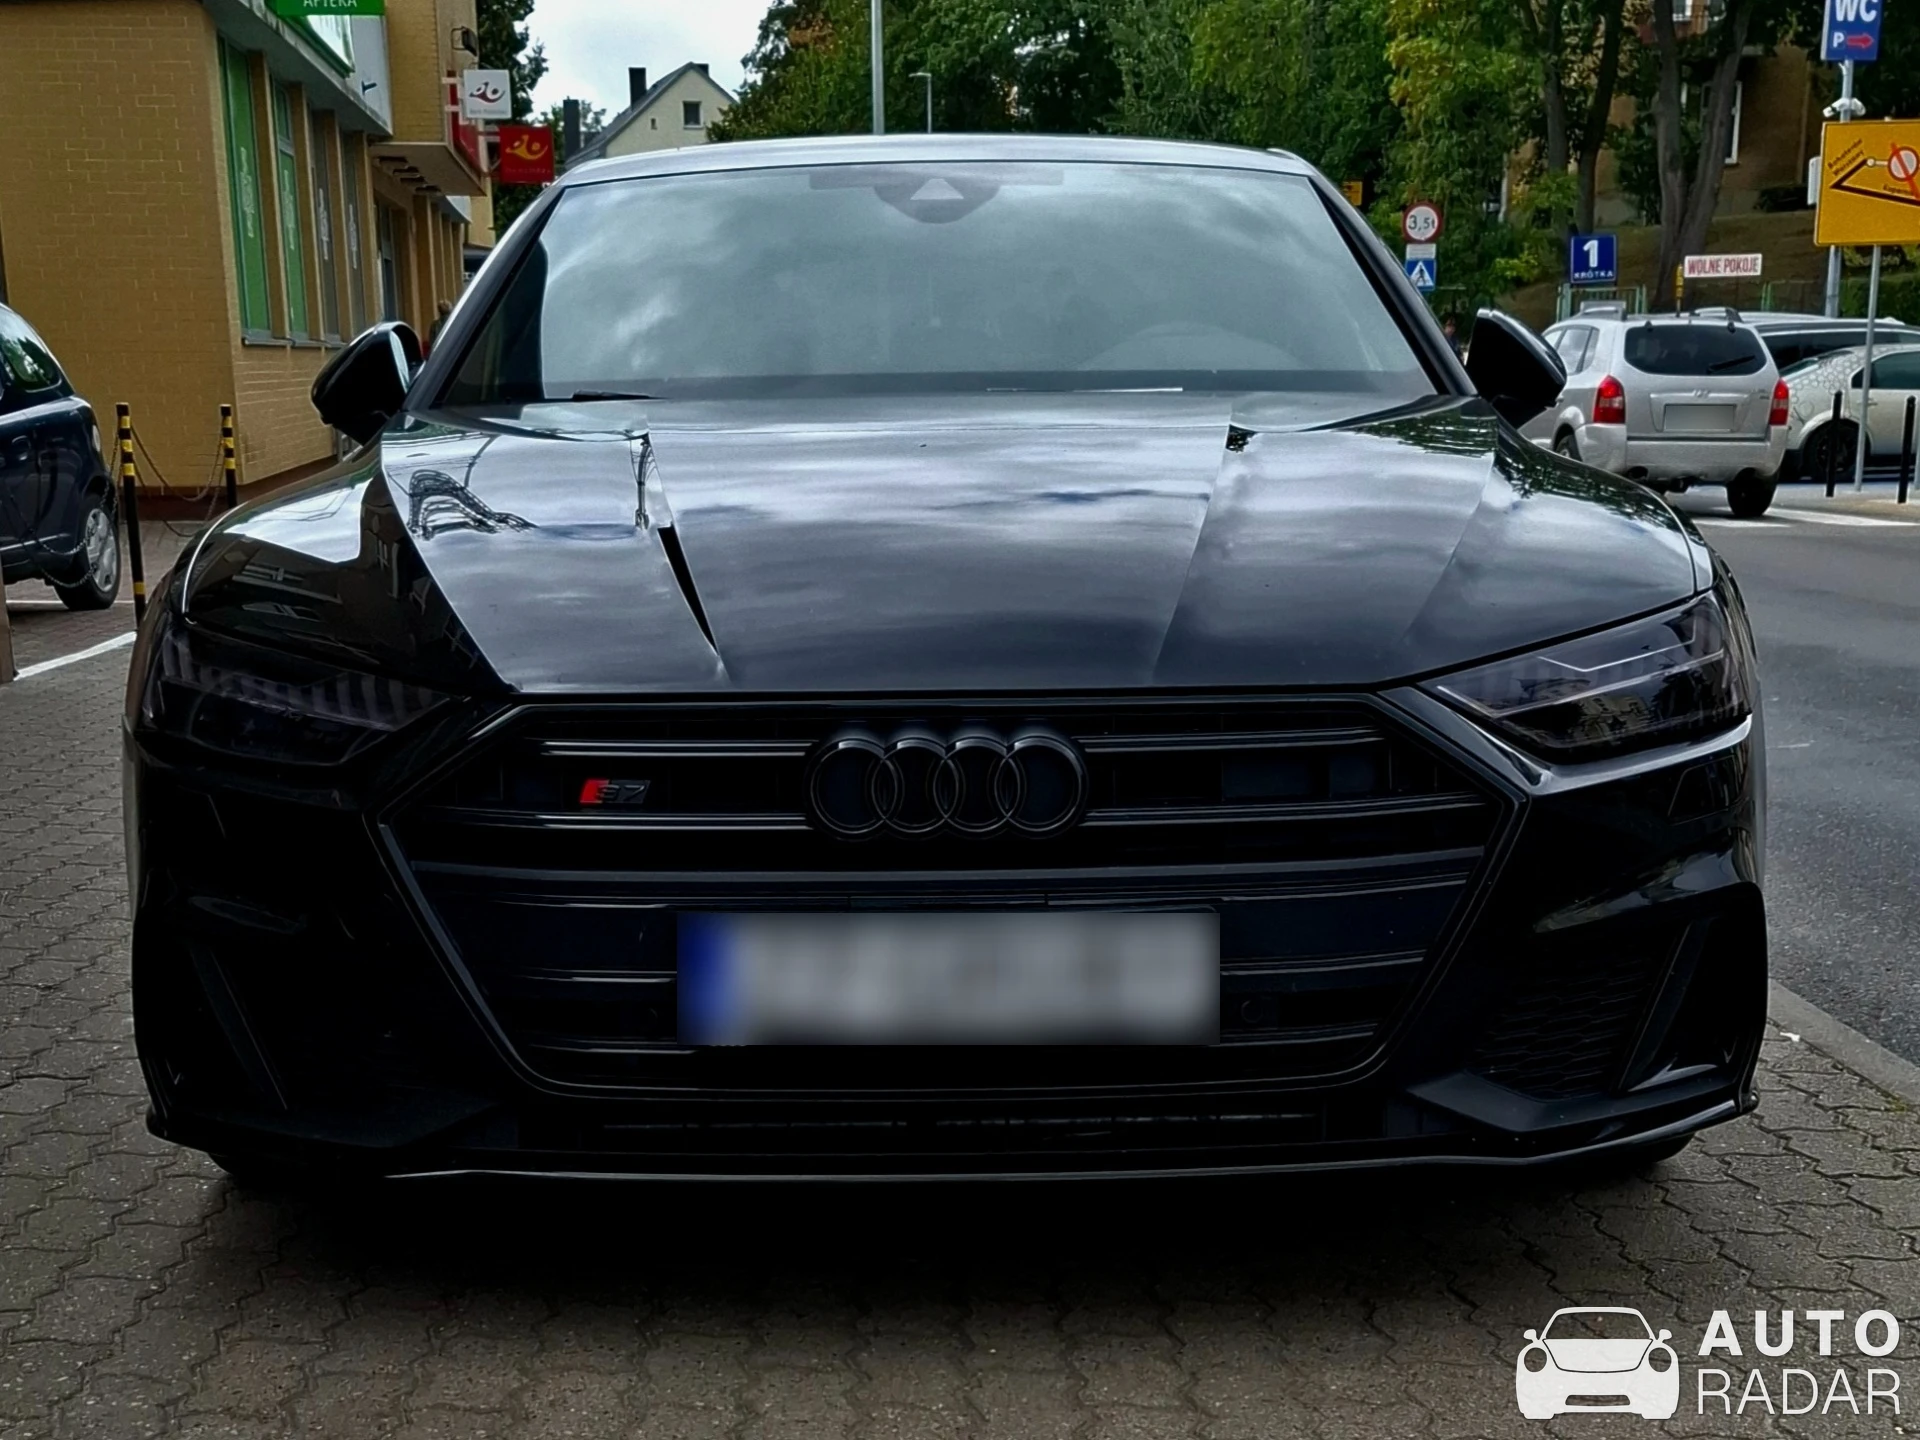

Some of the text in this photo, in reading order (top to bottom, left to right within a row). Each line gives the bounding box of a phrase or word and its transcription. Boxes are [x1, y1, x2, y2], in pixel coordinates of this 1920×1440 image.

[1835, 0, 1878, 22] WC
[1832, 32, 1845, 48] P
[1583, 239, 1599, 268] 1
[1573, 268, 1614, 279] KRÓTKA
[1687, 256, 1760, 274] WOLNE POKOJE
